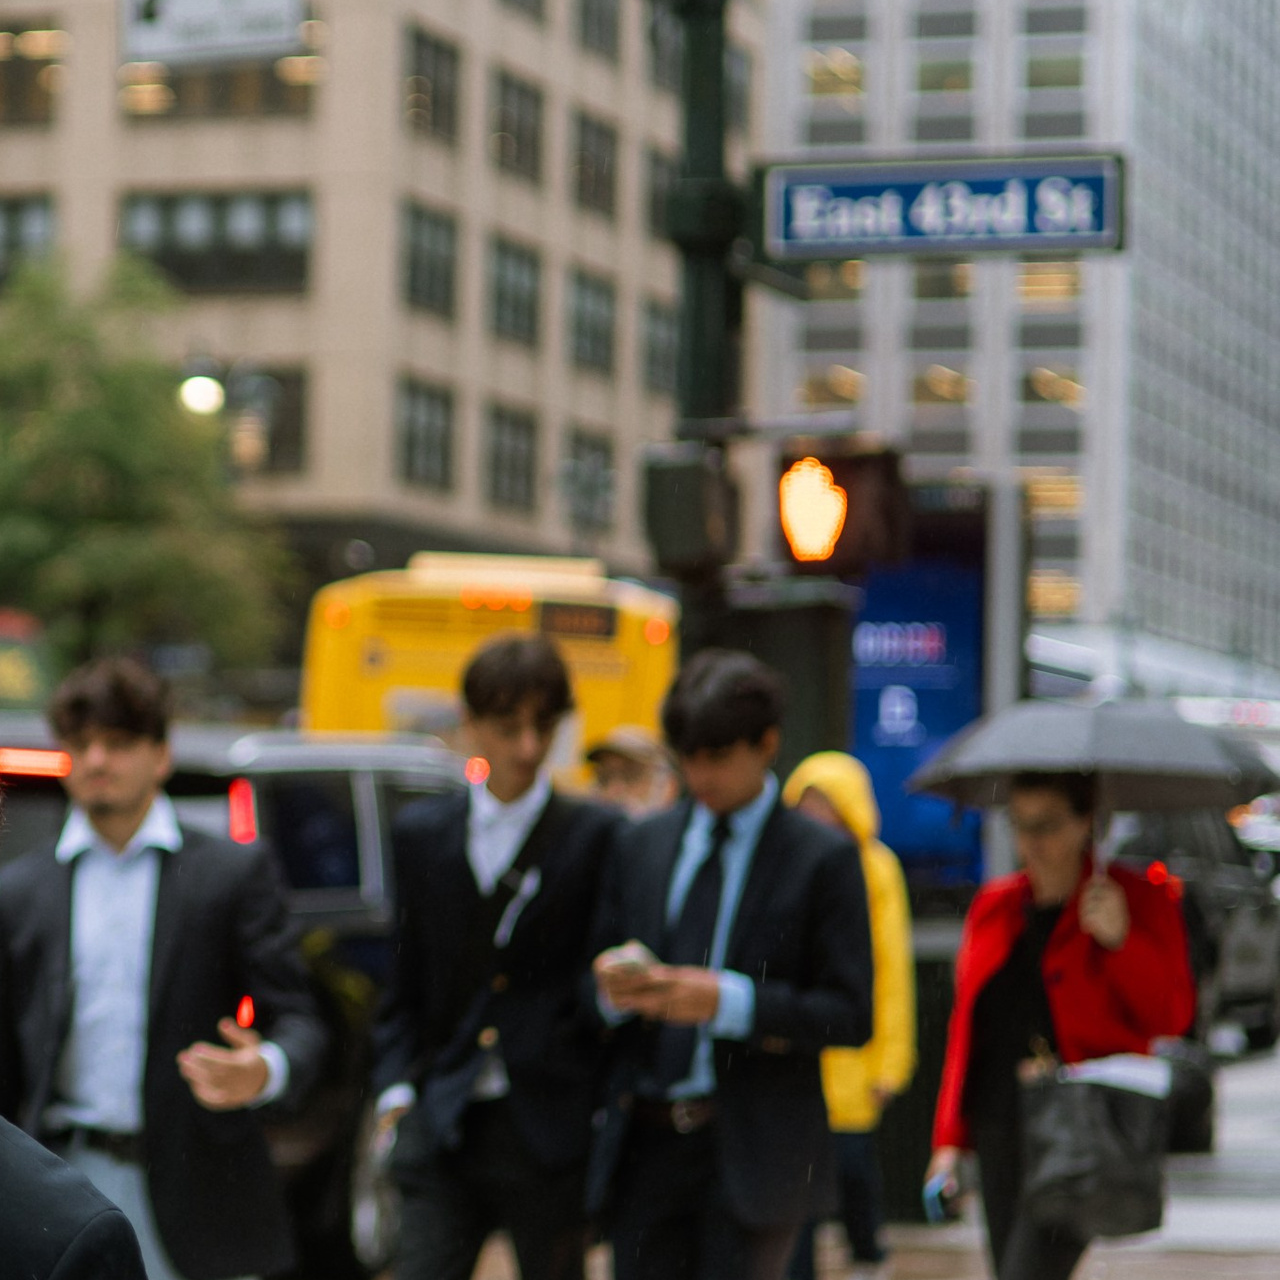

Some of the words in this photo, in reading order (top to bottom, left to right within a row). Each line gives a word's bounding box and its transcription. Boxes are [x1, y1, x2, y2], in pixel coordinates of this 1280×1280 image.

[790, 184, 903, 237] East
[910, 178, 1027, 236] 43rd
[1035, 176, 1097, 231] St
